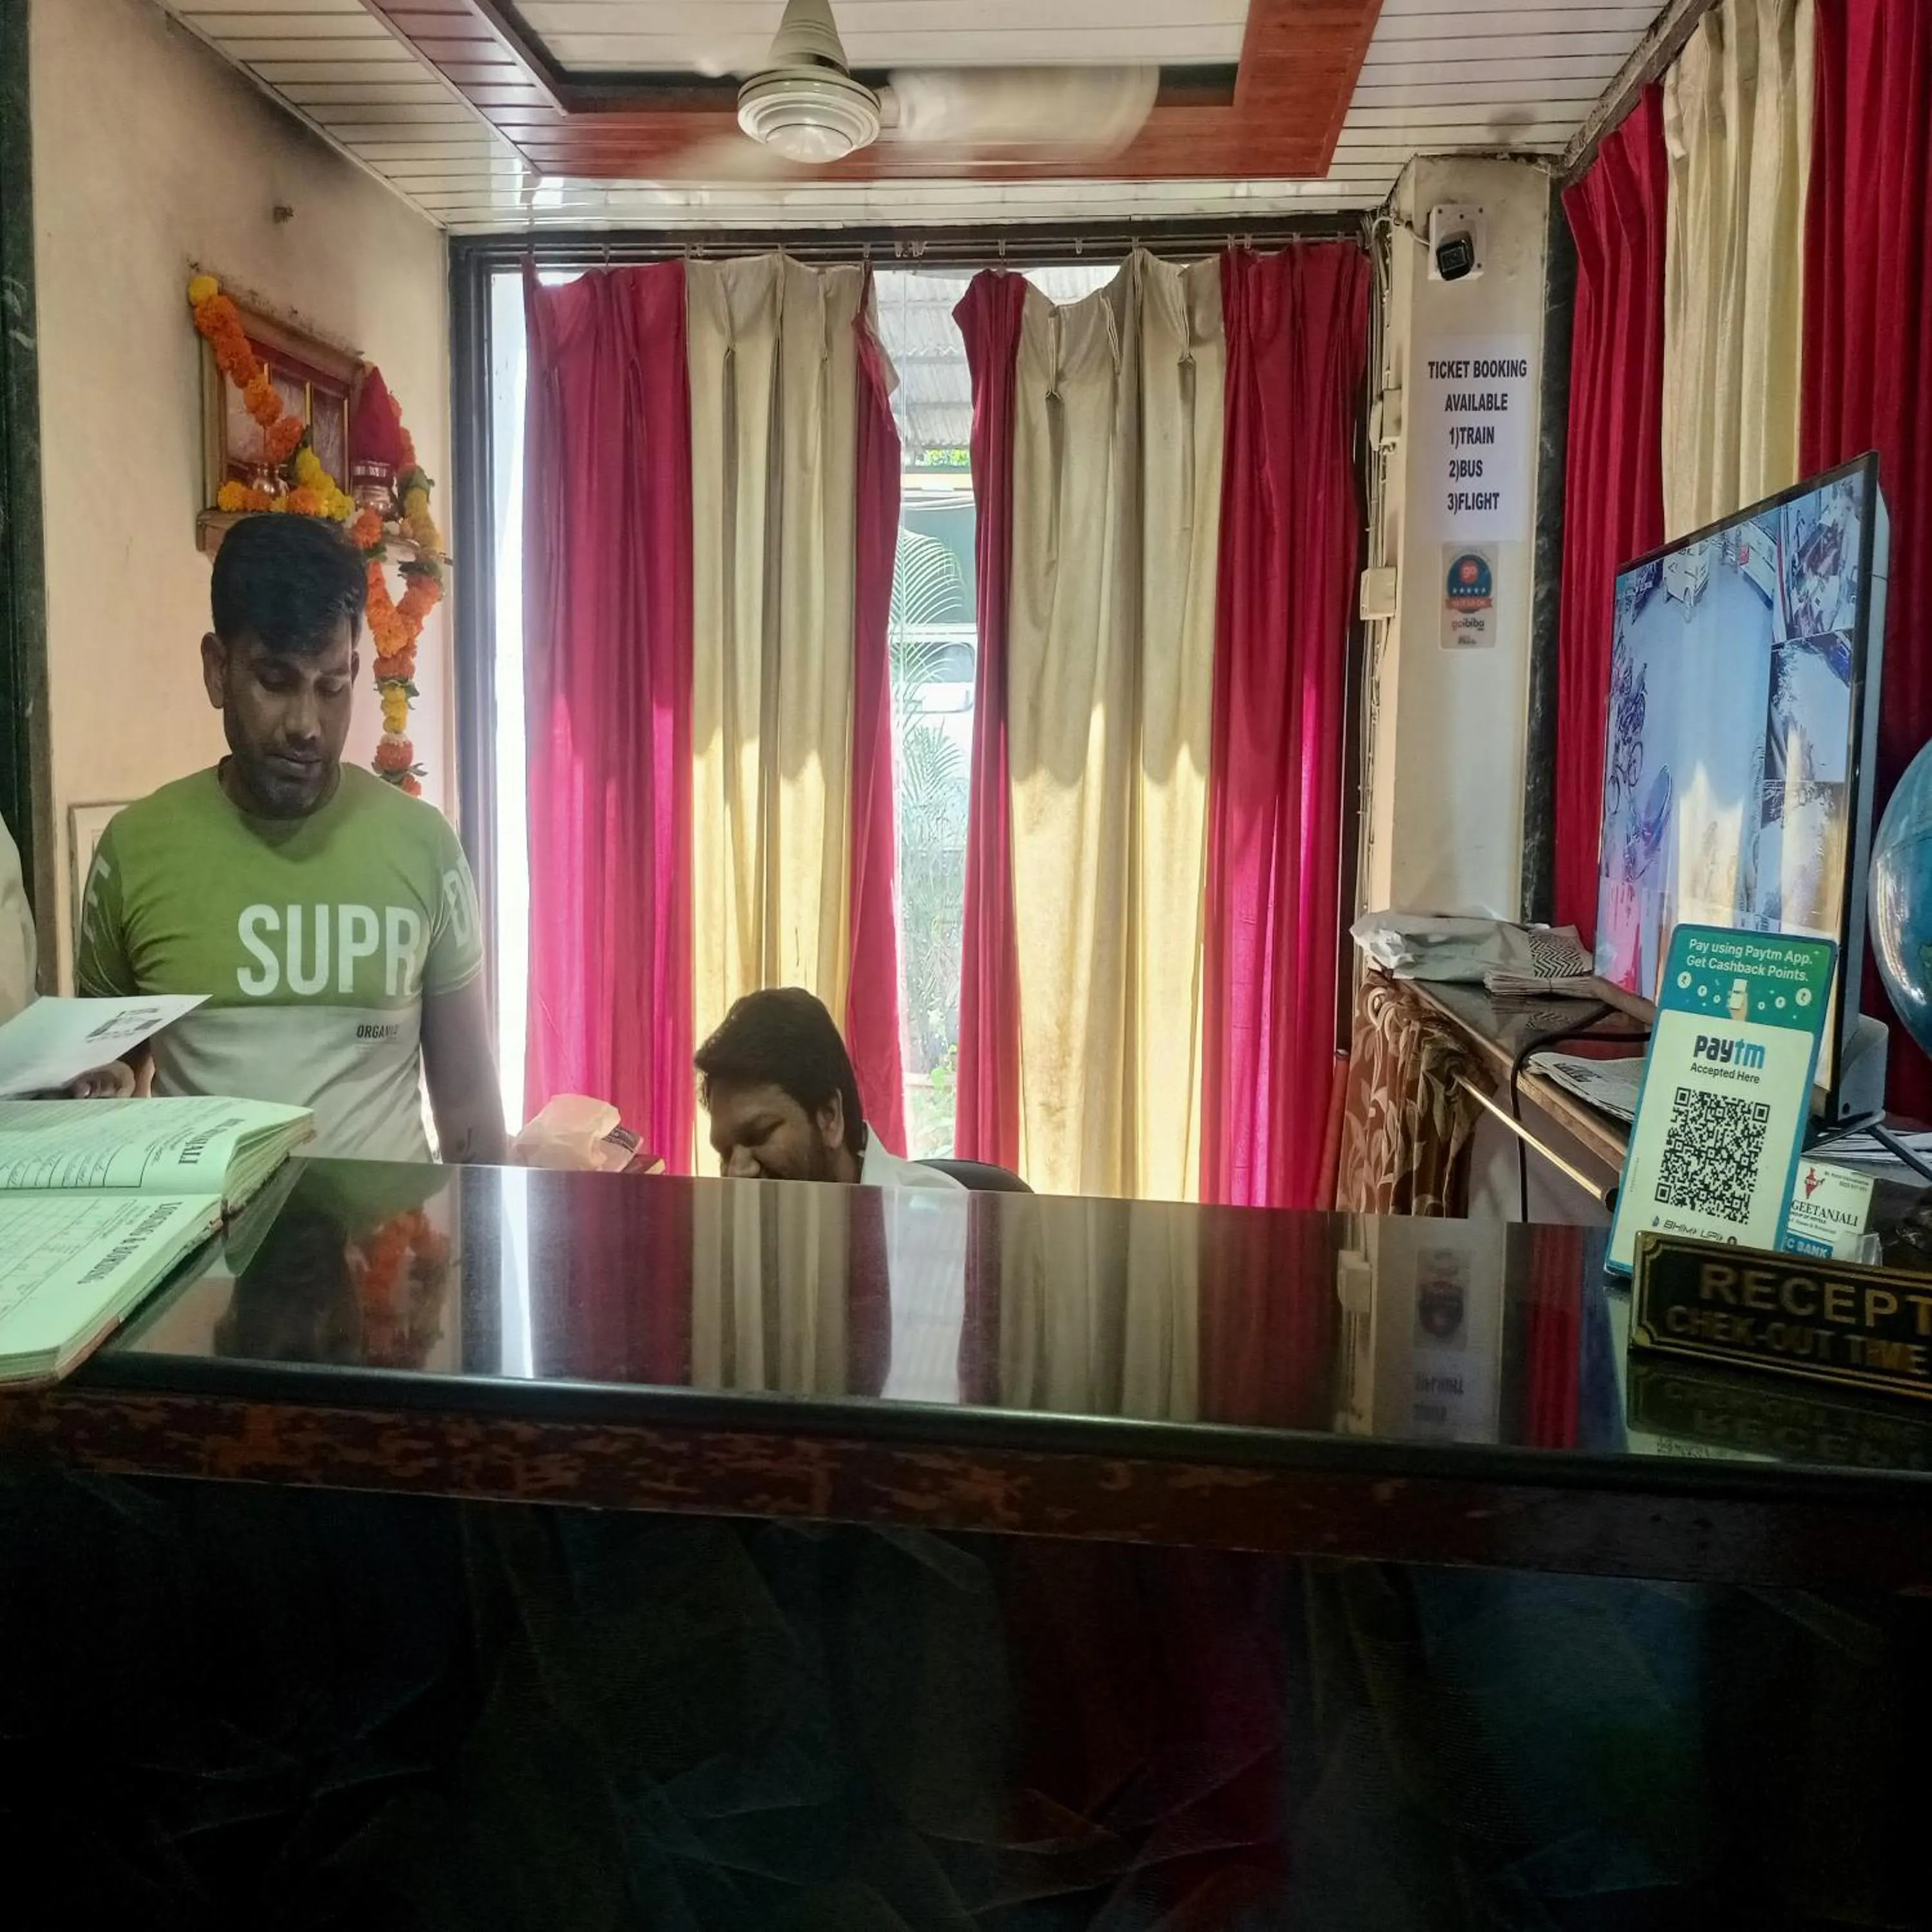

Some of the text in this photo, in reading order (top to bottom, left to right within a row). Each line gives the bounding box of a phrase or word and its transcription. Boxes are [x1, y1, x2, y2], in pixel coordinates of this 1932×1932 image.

[1428, 359, 1527, 379] TICKET BOOKING
[1444, 393, 1508, 412] AVAILABLE
[1449, 426, 1494, 450] 1)TRAIN
[1449, 460, 1482, 482] 2)BUS
[1448, 493, 1499, 515] 3)FLIGHT
[1689, 938, 1812, 965] Pay using Paytm App.
[1687, 955, 1809, 981] Get Cashback Points.
[1690, 1063, 1760, 1084] Accepted Here
[1792, 1200, 1858, 1226] GEETANJALI
[1700, 1263, 1932, 1336] RECEPT
